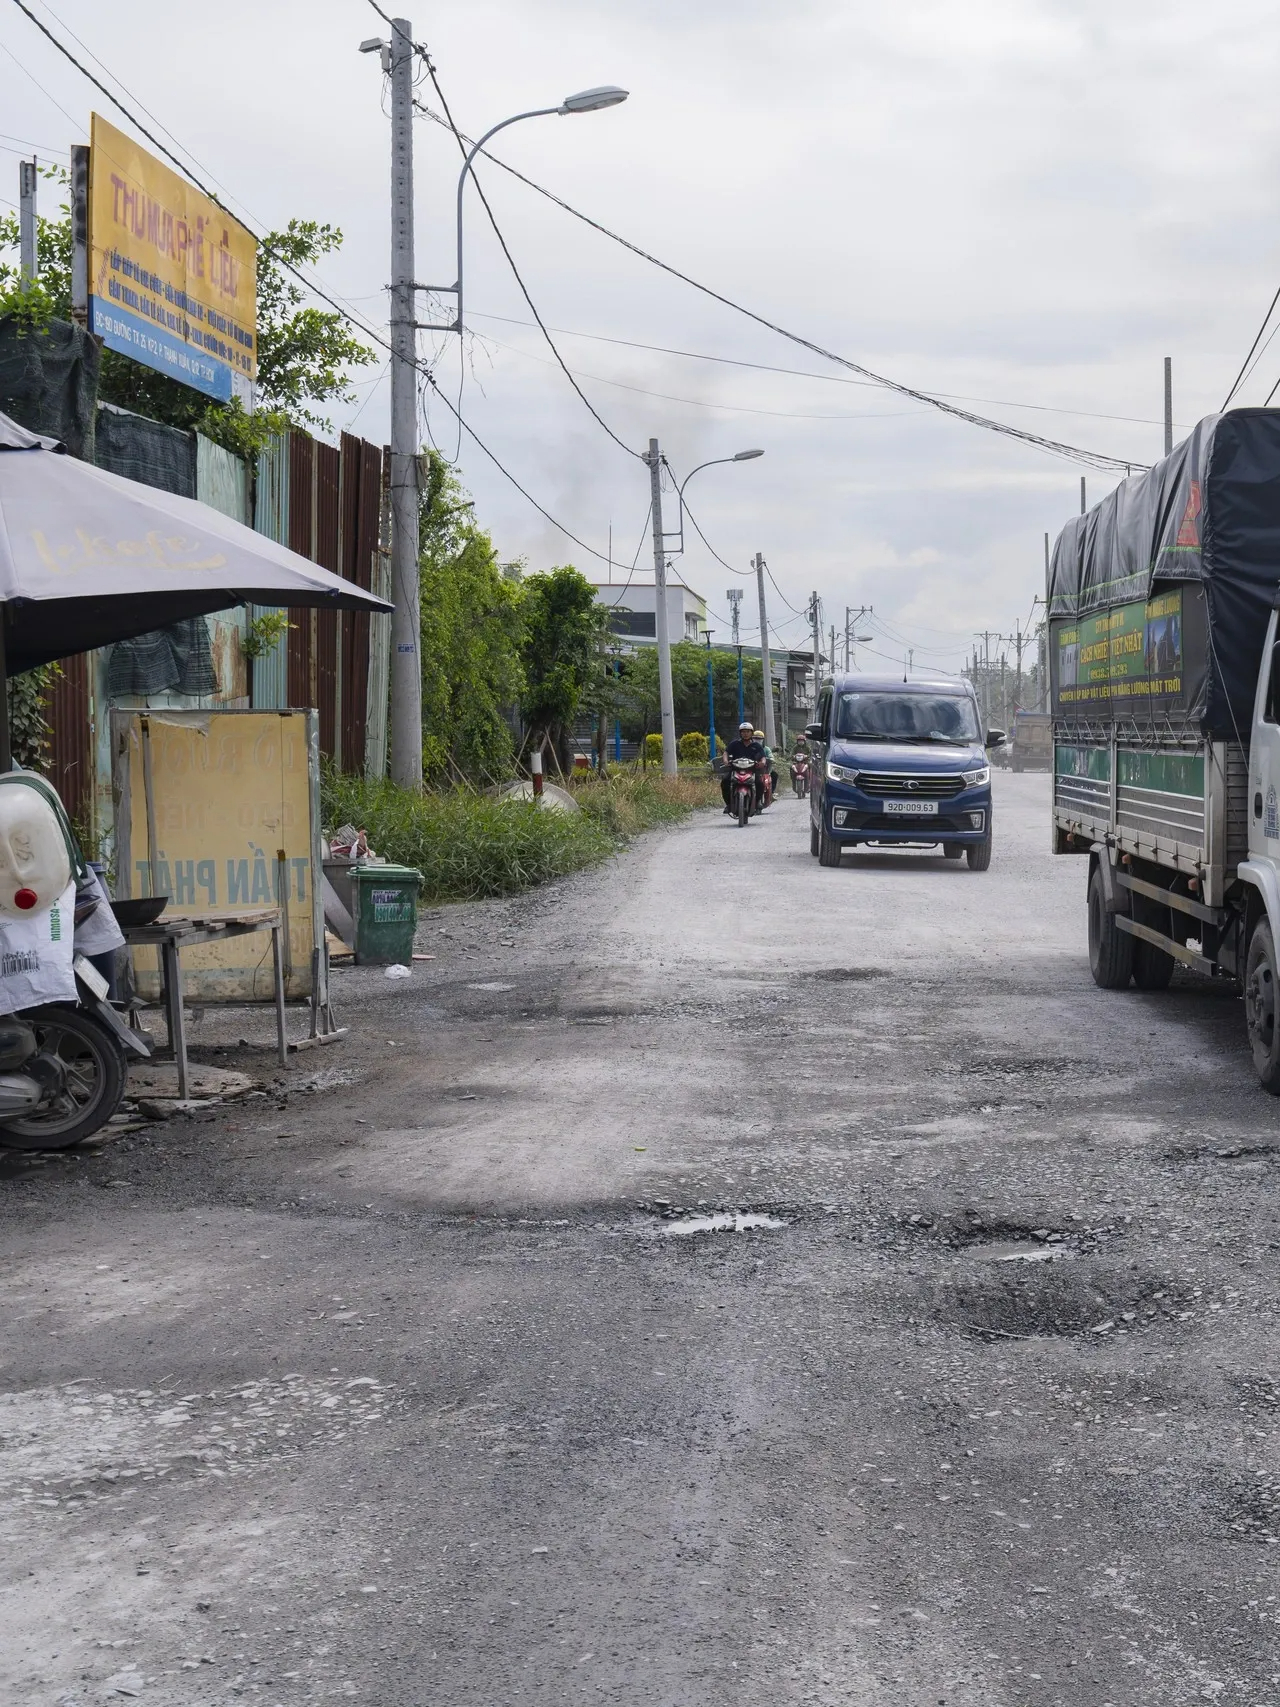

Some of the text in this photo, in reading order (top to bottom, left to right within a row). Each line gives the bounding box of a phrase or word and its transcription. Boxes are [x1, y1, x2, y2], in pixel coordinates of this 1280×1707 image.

[111, 172, 145, 240] THU
[147, 197, 176, 260] MUA
[177, 215, 209, 277] PHẾ
[51, 908, 61, 941] MIMOSA
